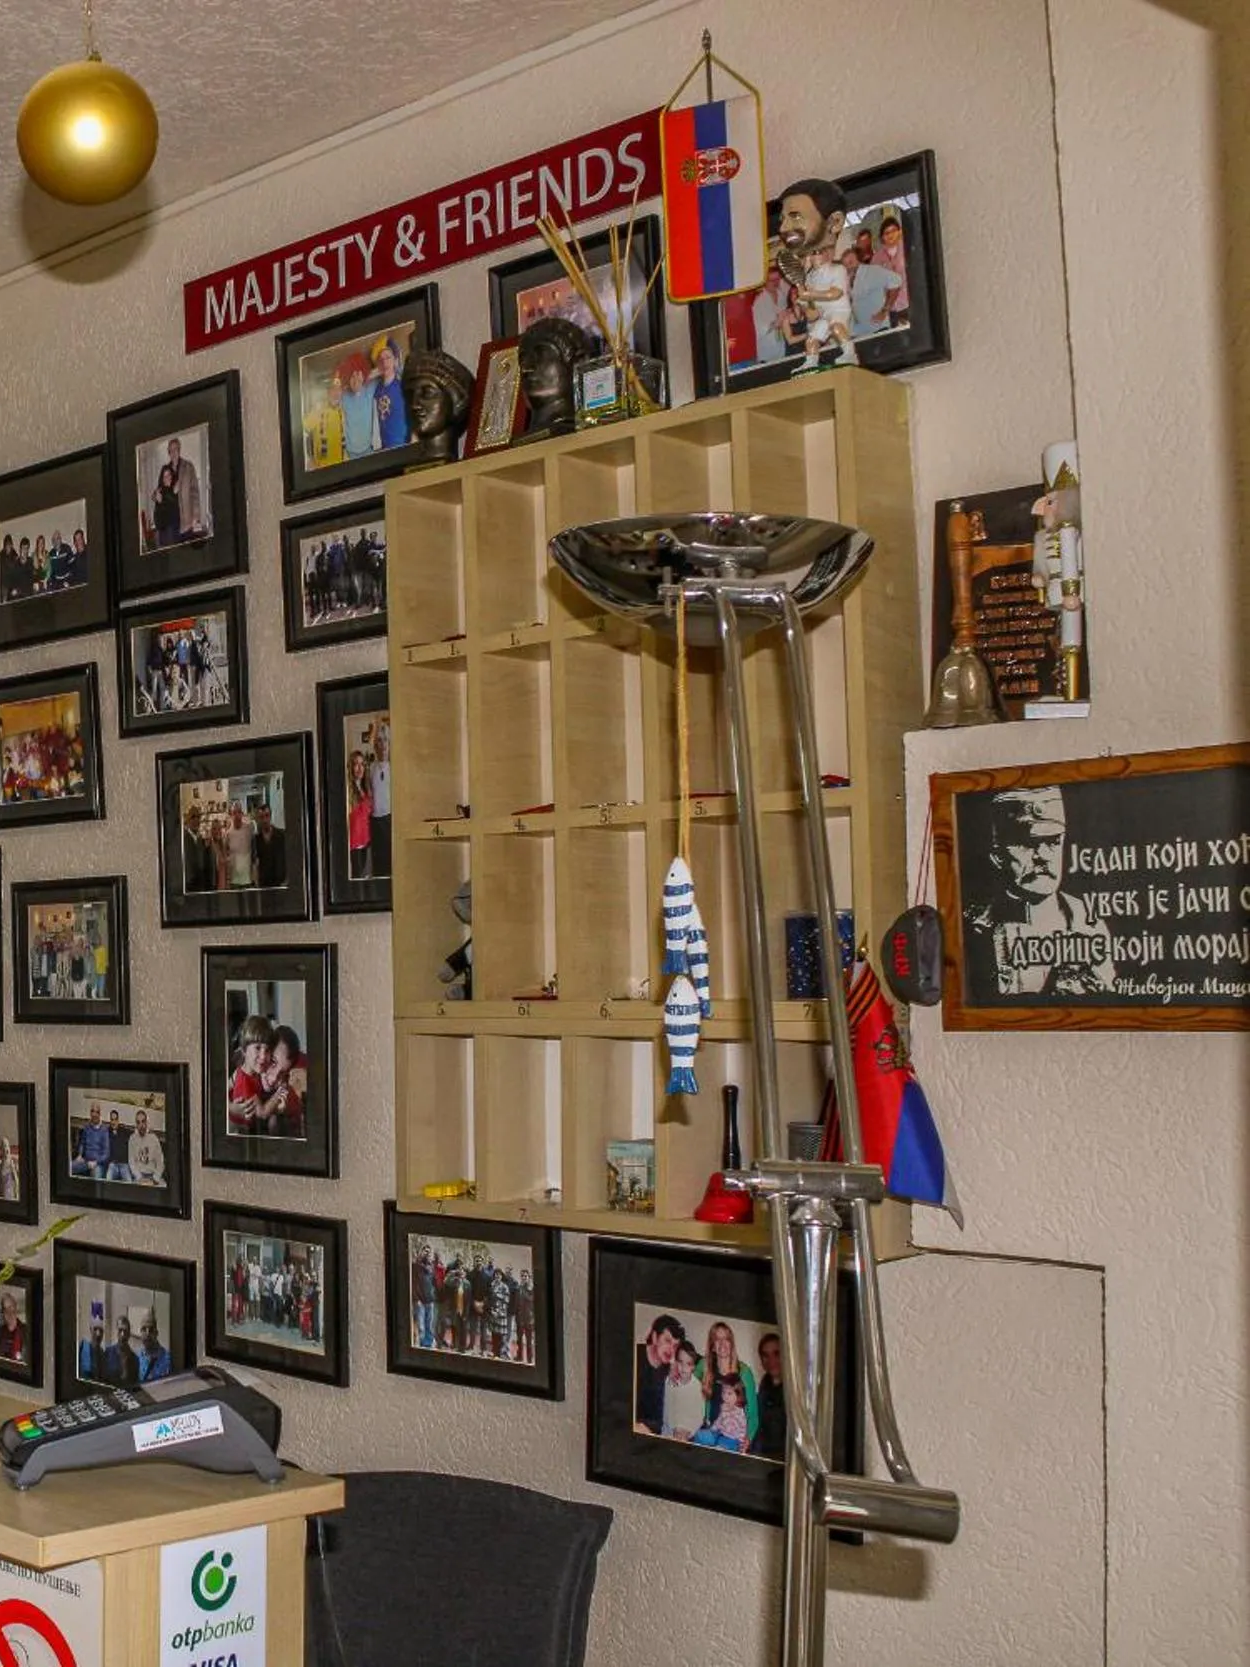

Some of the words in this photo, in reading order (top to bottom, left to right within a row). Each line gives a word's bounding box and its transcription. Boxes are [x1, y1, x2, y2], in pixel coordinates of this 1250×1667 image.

[203, 225, 382, 334] MAJESTY
[393, 213, 426, 268] &
[438, 132, 647, 254] FRIENDS
[1146, 837, 1198, 873] који
[1147, 884, 1170, 920] је
[1176, 882, 1230, 919] јачи
[1113, 930, 1164, 966] који
[1200, 976, 1250, 998] Миш
[171, 1612, 255, 1652] otpbanka
